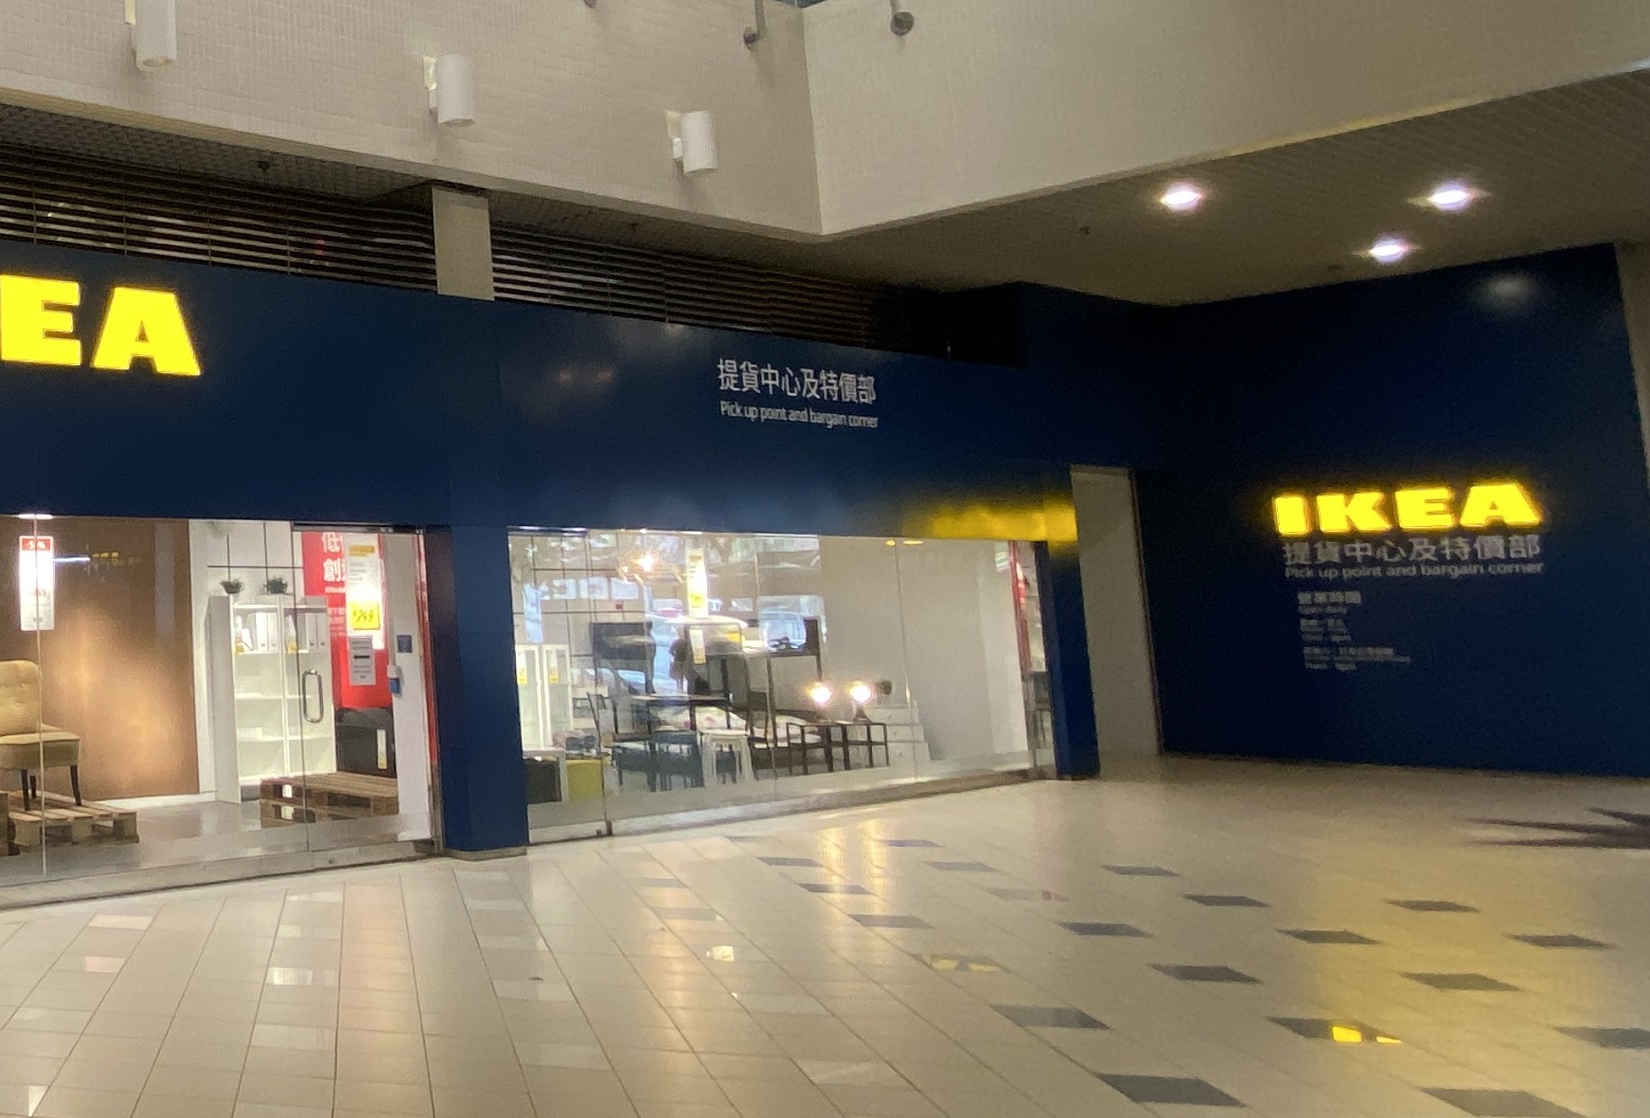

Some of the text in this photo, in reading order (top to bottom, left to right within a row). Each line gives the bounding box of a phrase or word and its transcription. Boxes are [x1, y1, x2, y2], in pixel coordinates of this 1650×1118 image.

[718, 358, 877, 405] 提貨中心及特價部
[720, 400, 879, 429] Pick up point and bargain corner
[1274, 483, 1542, 535] IKEA
[26, 540, 47, 551] -5%
[1284, 534, 1541, 566] 提貨中心及特價部
[323, 557, 346, 583] 創
[1285, 563, 1545, 581] Pick up point and bargain corner
